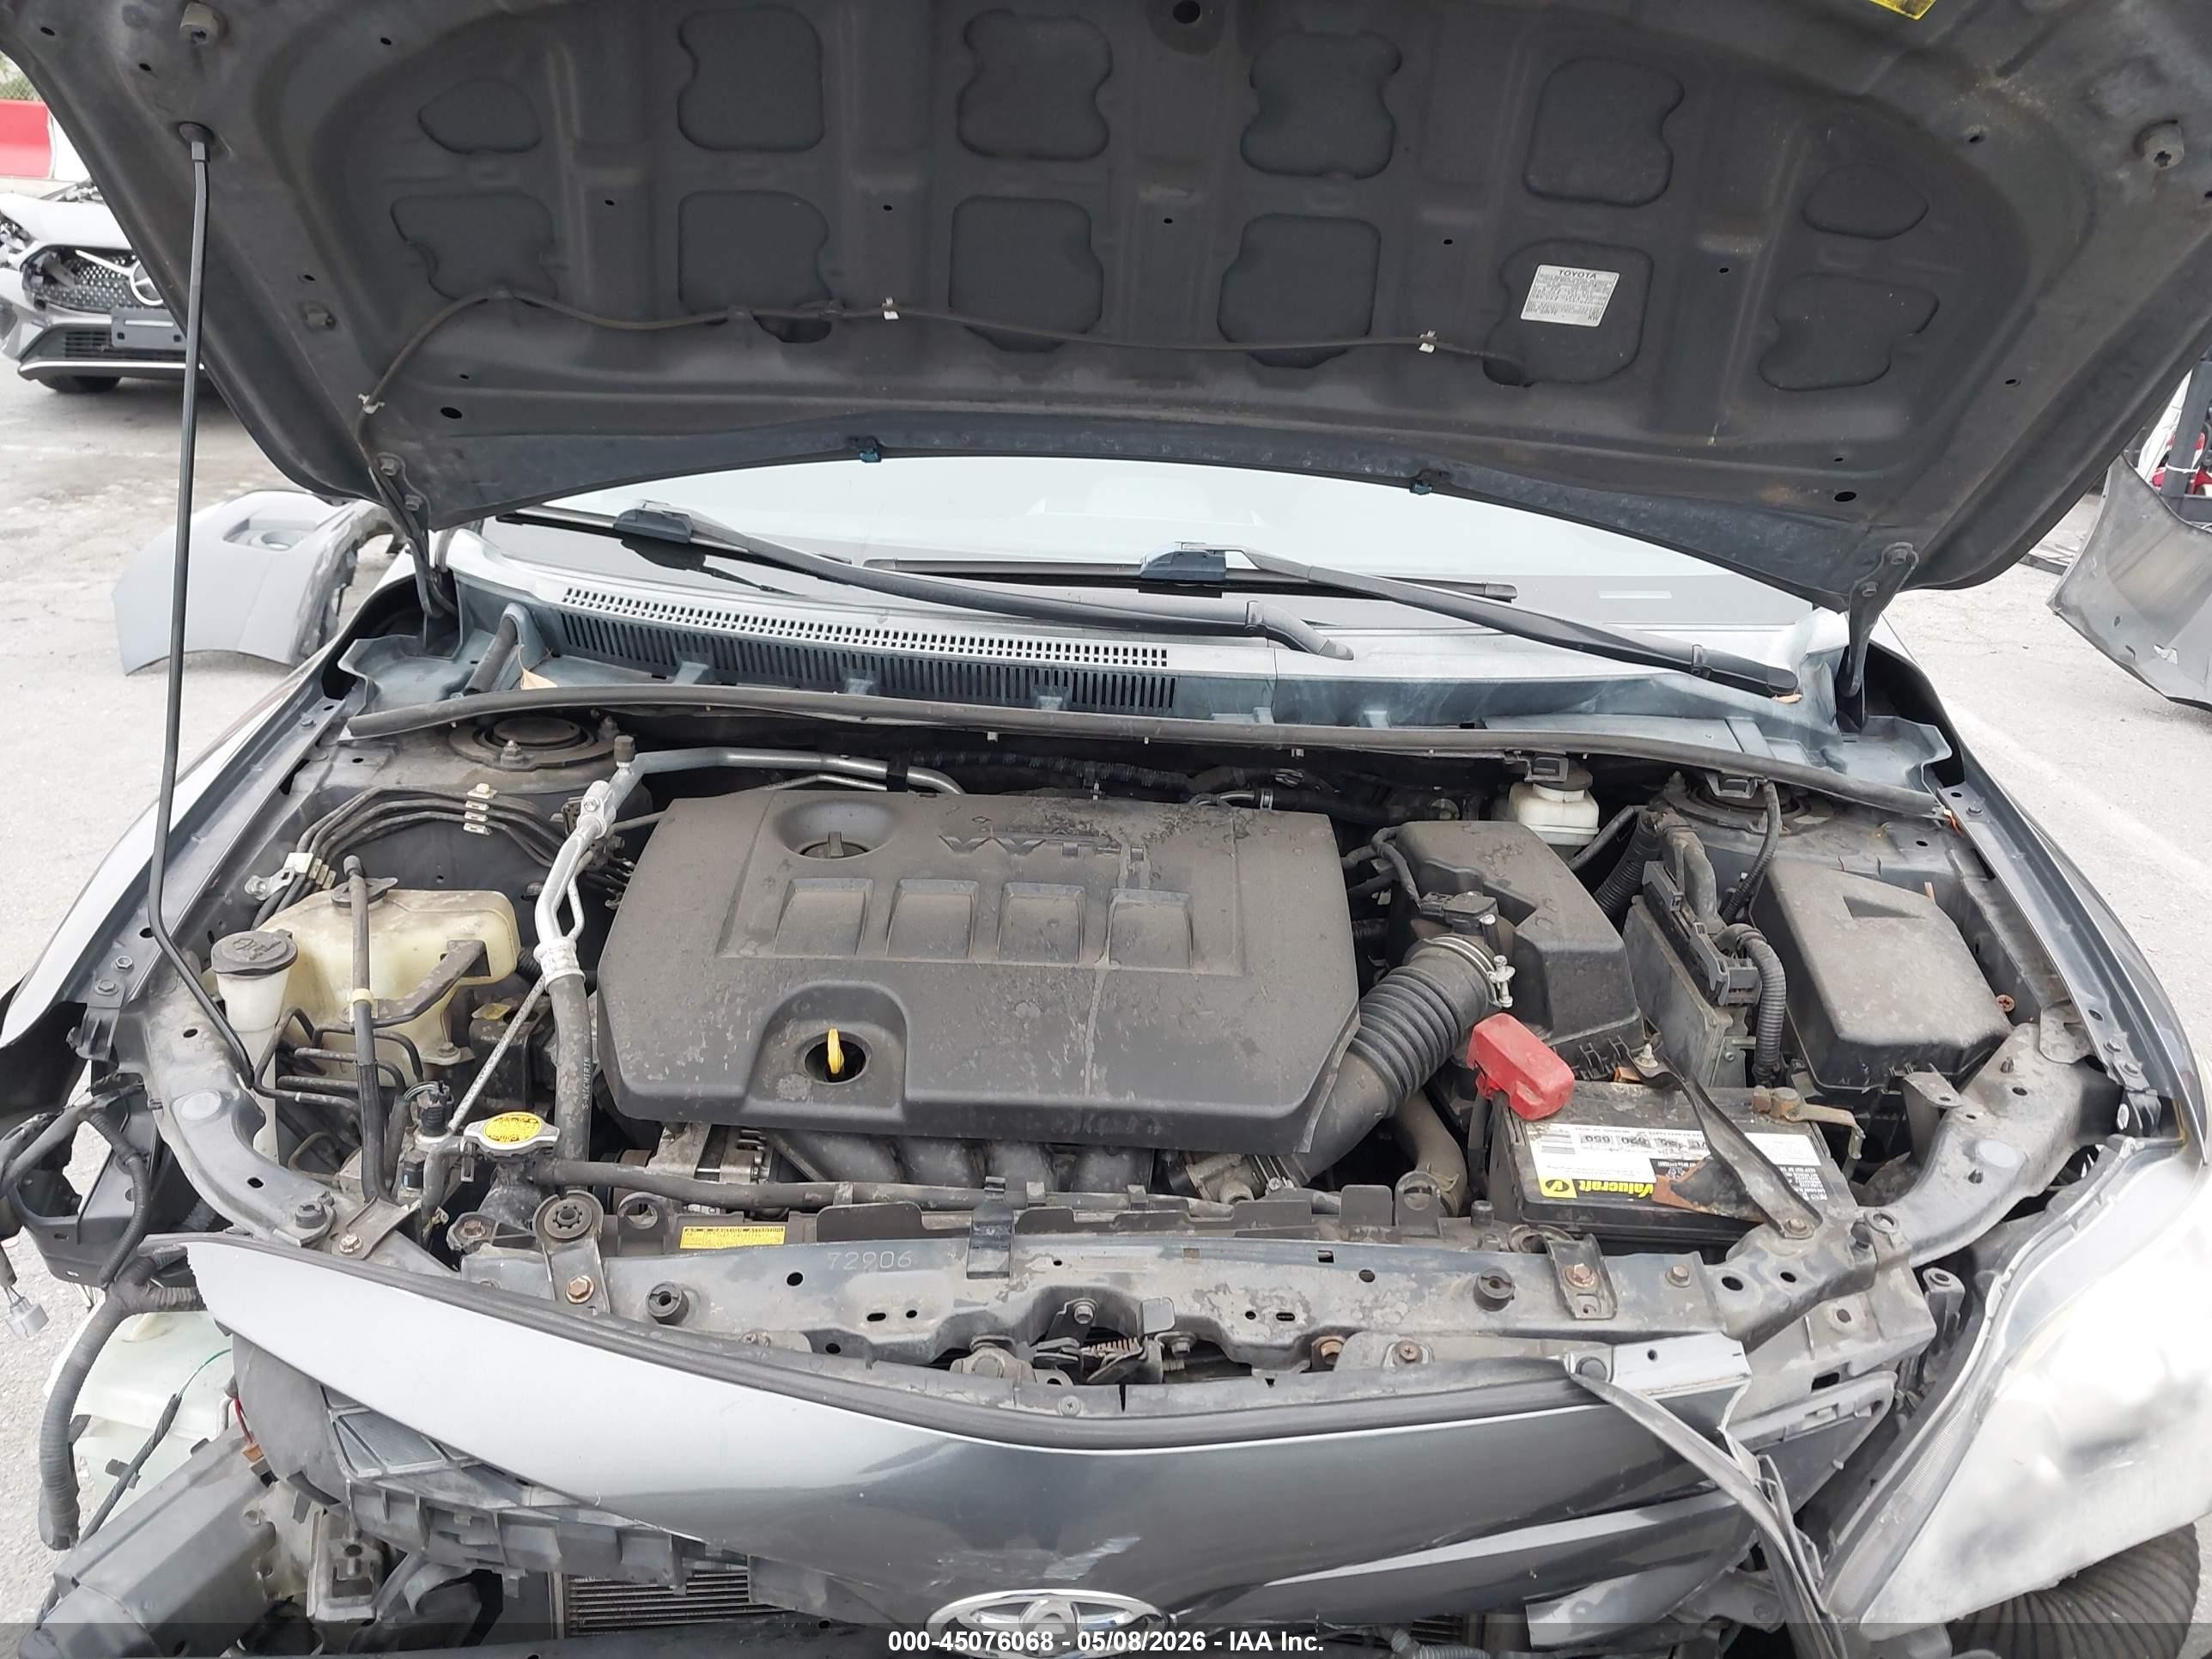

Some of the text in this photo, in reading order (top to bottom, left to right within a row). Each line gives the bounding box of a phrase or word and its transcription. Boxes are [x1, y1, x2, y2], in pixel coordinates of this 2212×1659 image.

[1559, 270, 1597, 279] TOYOTA
[1578, 1180, 1654, 1199] Valucraft
[827, 1249, 913, 1271] 72906
